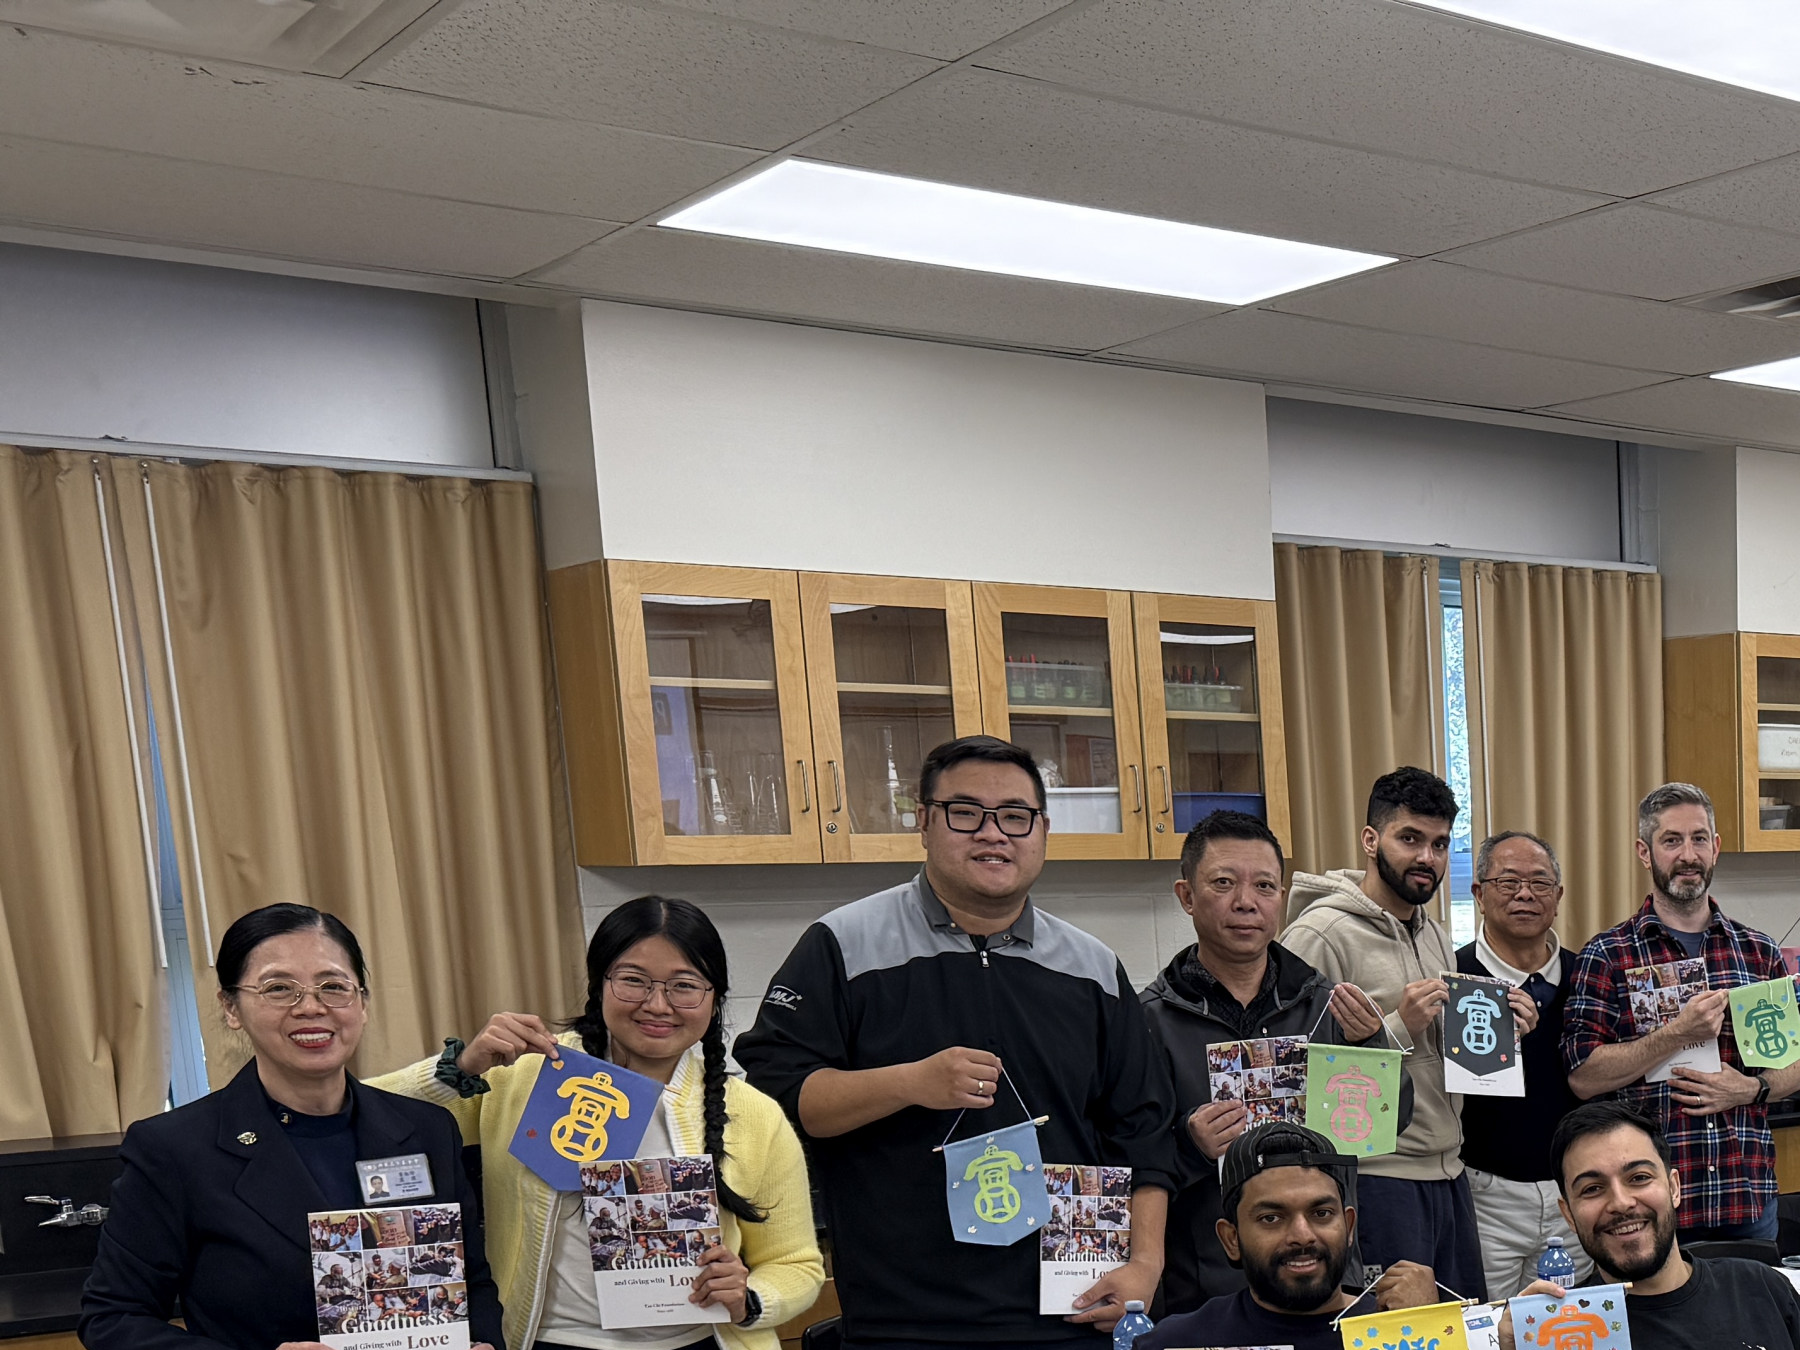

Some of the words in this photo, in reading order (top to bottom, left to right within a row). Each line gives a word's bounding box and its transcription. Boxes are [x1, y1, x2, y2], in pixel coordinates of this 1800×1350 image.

[611, 1253, 698, 1271] Goodnes
[1054, 1248, 1118, 1262] Goodness
[627, 1278, 650, 1287] Giving
[650, 1277, 665, 1285] with
[669, 1274, 700, 1287] Lov
[341, 1311, 450, 1335] Goodness
[343, 1341, 358, 1350] and
[385, 1339, 402, 1349] with
[407, 1332, 450, 1350] Love
